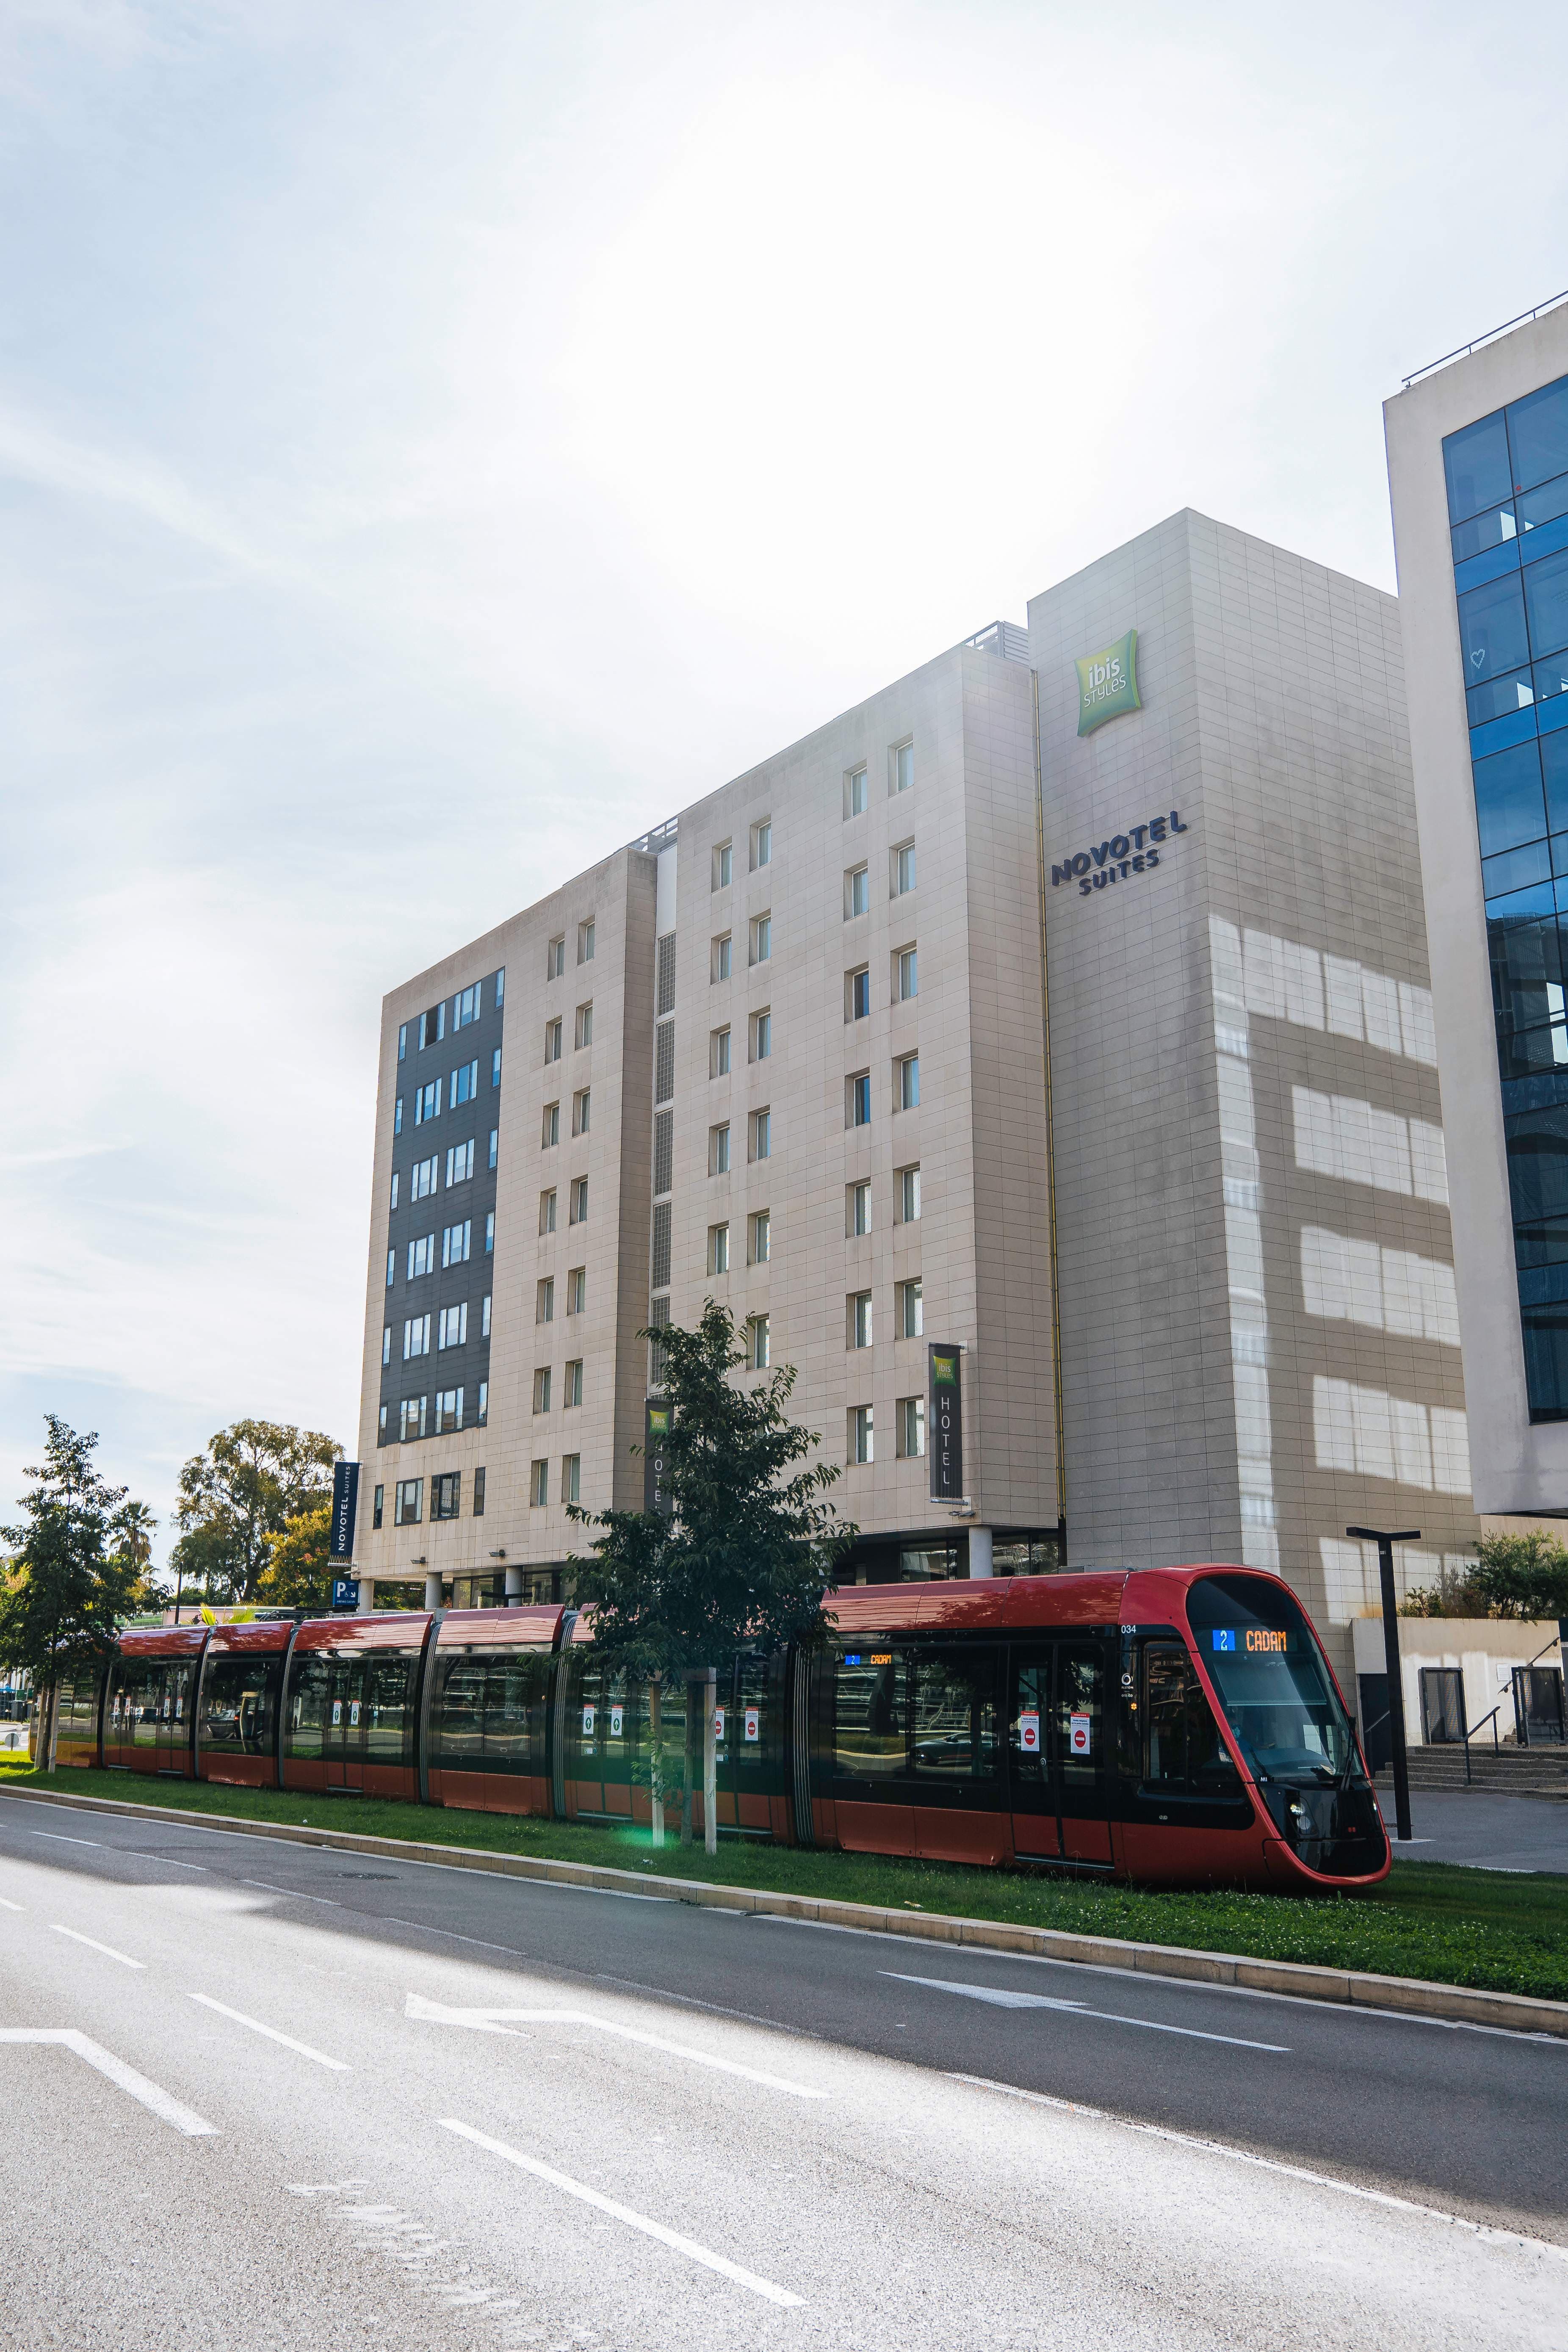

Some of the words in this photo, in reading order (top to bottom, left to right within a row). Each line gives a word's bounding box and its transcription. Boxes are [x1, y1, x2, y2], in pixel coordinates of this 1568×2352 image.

[1089, 657, 1120, 689] ibis
[1052, 811, 1187, 886] NOVOTEL
[1079, 849, 1160, 896] SUITES
[938, 1363, 951, 1372] ibis
[654, 1416, 665, 1424] ibis
[941, 1397, 950, 1484] HOTEL
[338, 1497, 348, 1551] NOVOTEL
[337, 1582, 346, 1597] P
[1121, 1625, 1137, 1634] 034
[1220, 1630, 1228, 1651] 2
[1246, 1631, 1287, 1651] CADAM
[851, 1655, 855, 1664] 2
[871, 1655, 891, 1665] CADAM
